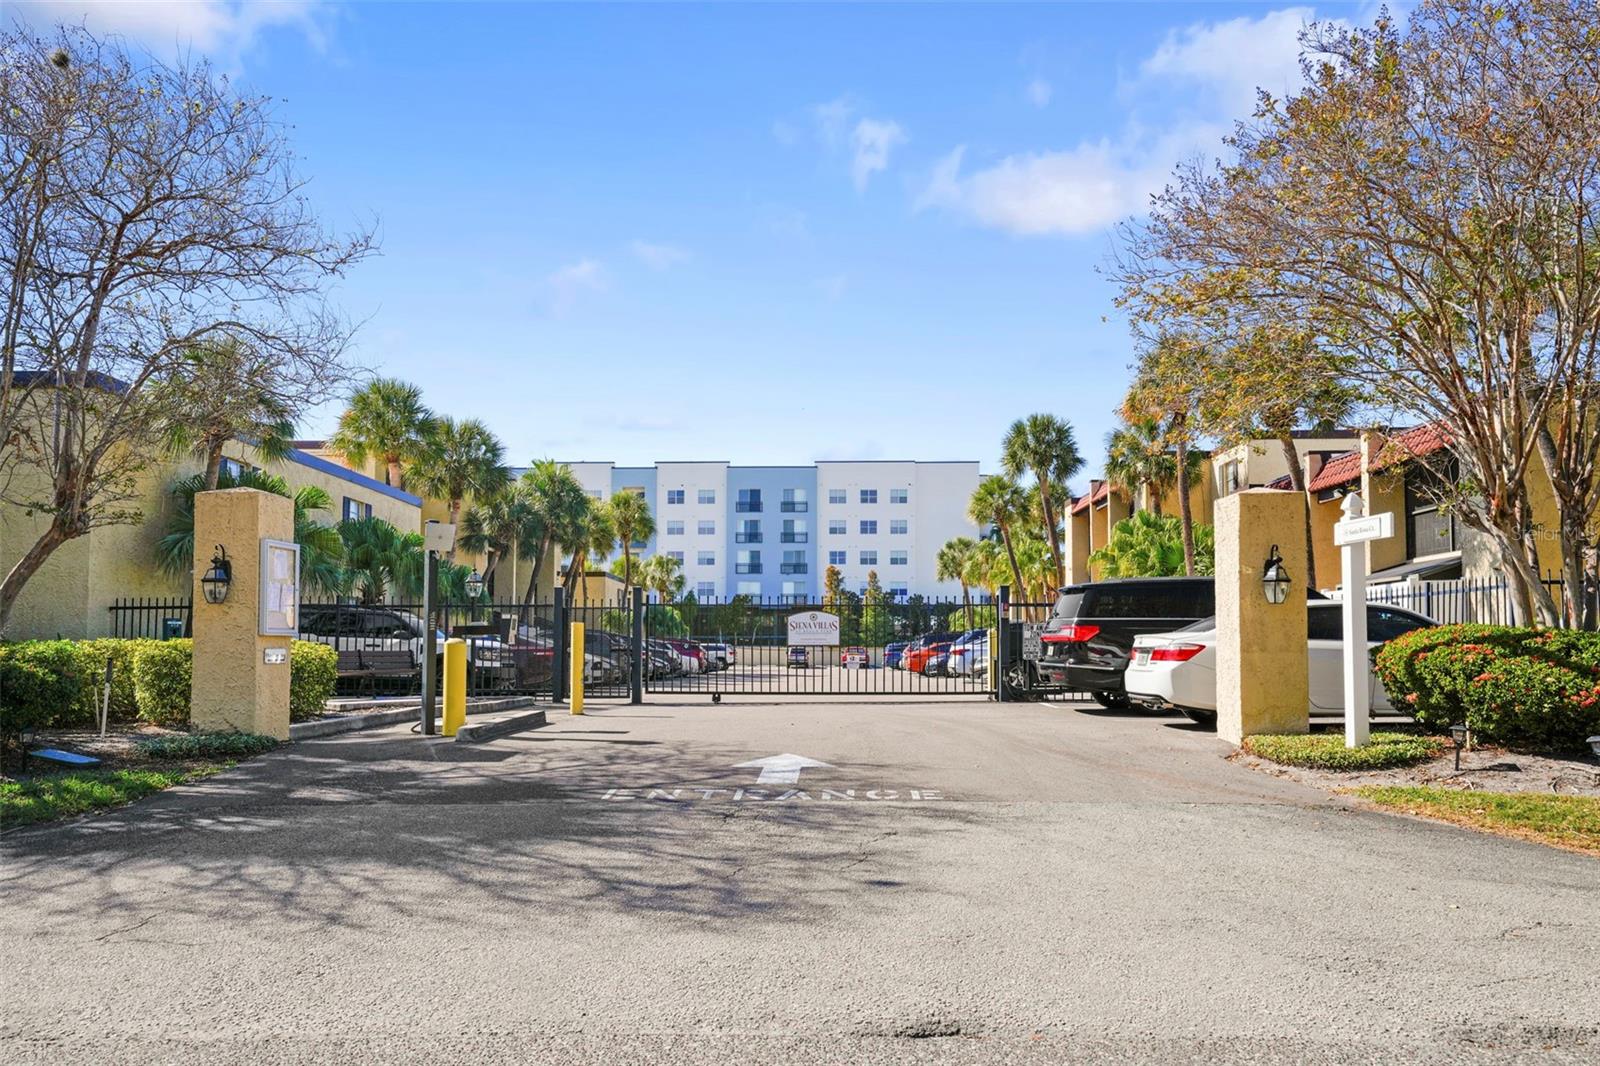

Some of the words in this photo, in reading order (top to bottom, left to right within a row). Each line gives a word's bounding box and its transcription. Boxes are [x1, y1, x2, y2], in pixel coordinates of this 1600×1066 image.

[789, 620, 812, 631] SIENA
[812, 620, 838, 631] VILLAS
[601, 788, 944, 801] ENTRANCE
